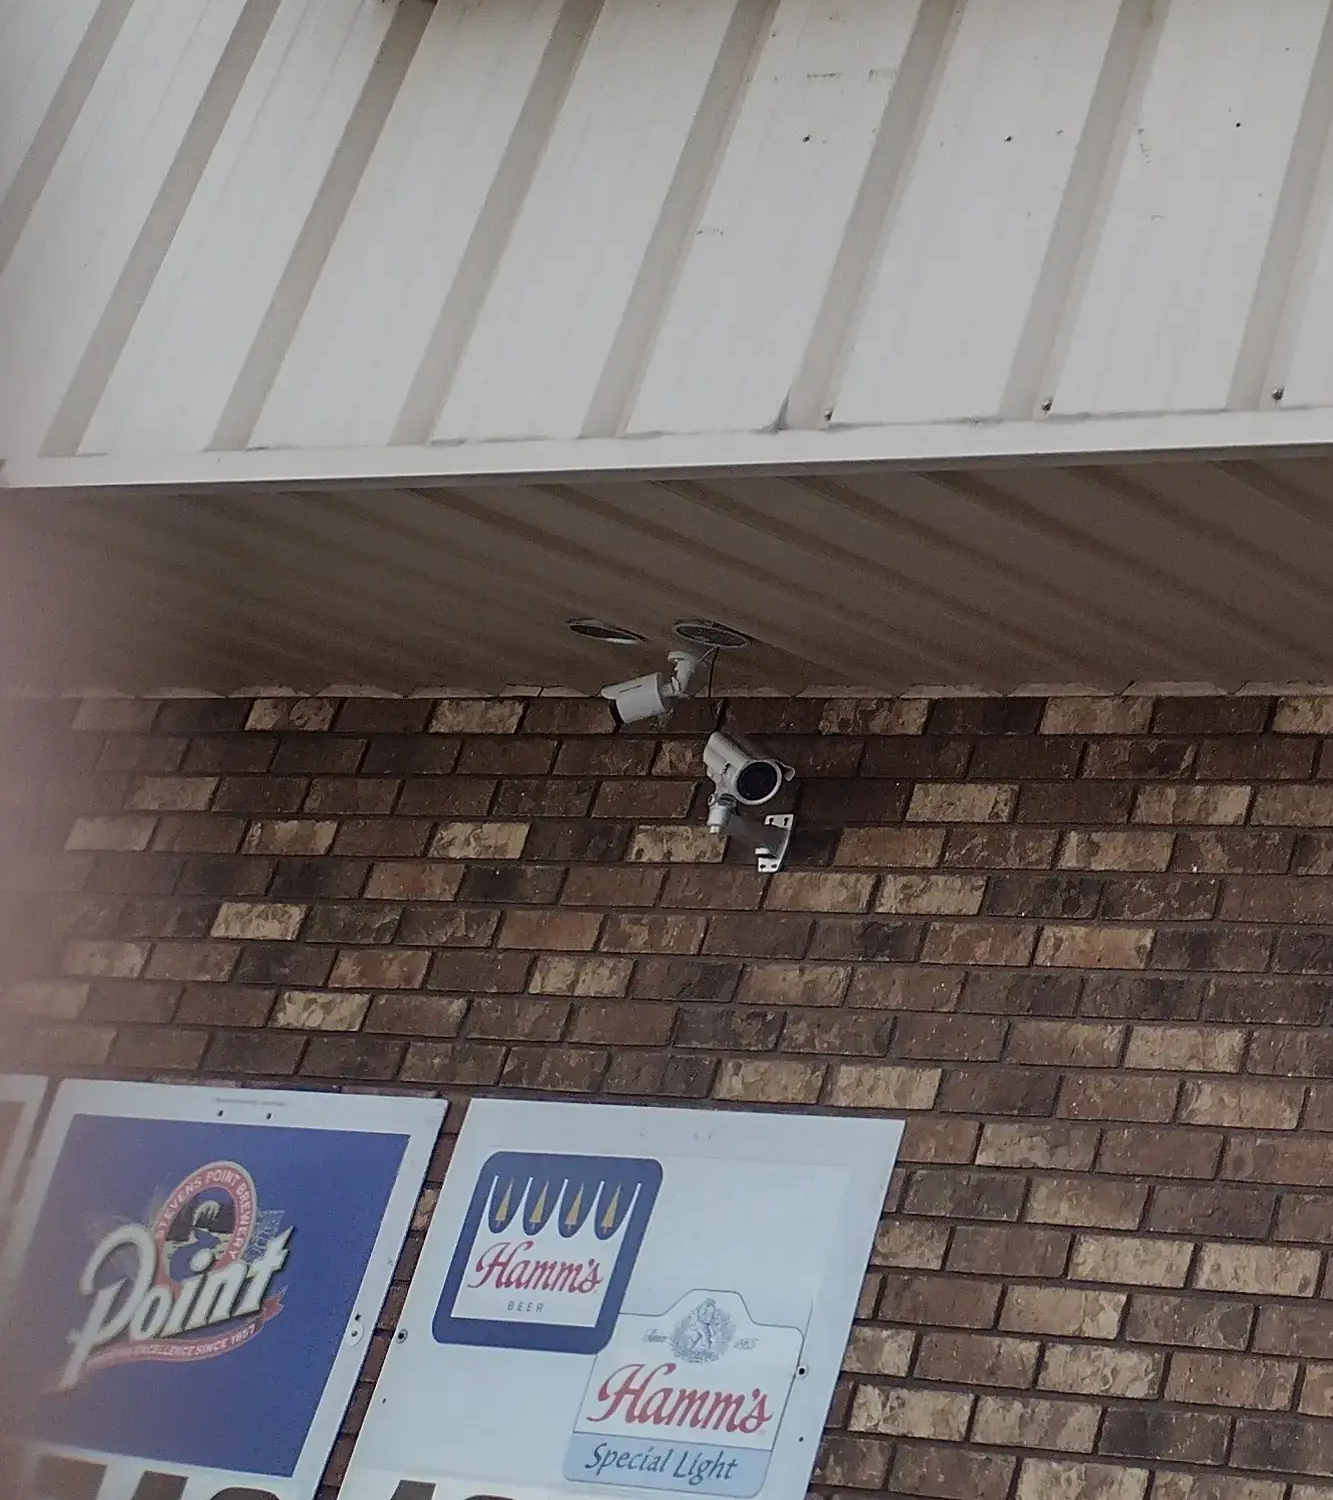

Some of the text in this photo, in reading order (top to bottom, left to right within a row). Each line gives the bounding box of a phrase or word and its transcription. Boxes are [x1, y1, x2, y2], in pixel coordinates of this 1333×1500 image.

[206, 1168, 241, 1188] POINT
[228, 1182, 252, 1260] BREWERY
[466, 1240, 604, 1294] Hamm's
[55, 1224, 295, 1387] Point
[507, 1299, 545, 1314] BEER
[195, 1338, 228, 1355] SINCE
[586, 1363, 774, 1434] Hamm's
[584, 1442, 738, 1486] Special Light
